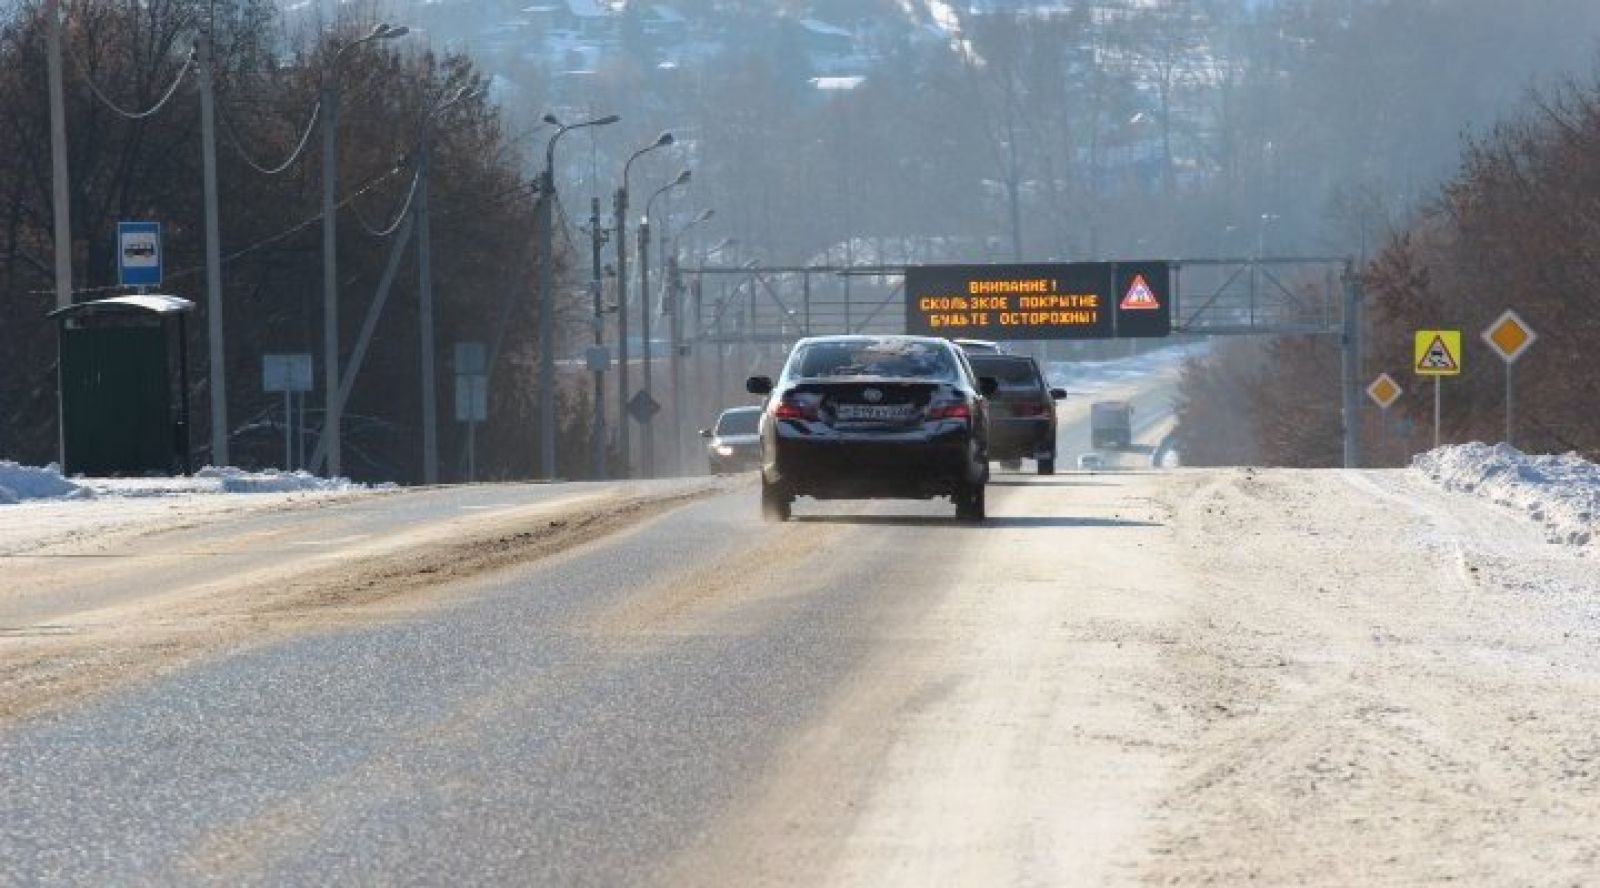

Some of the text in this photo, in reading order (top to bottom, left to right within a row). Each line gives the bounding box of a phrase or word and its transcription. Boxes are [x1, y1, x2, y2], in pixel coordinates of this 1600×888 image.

[921, 295, 1098, 310] СКОЛЬЗКОЕ ПОКРЫТИЕ
[930, 311, 1097, 327] БУДЬТЕ ОСТОРОЖНЫ!
